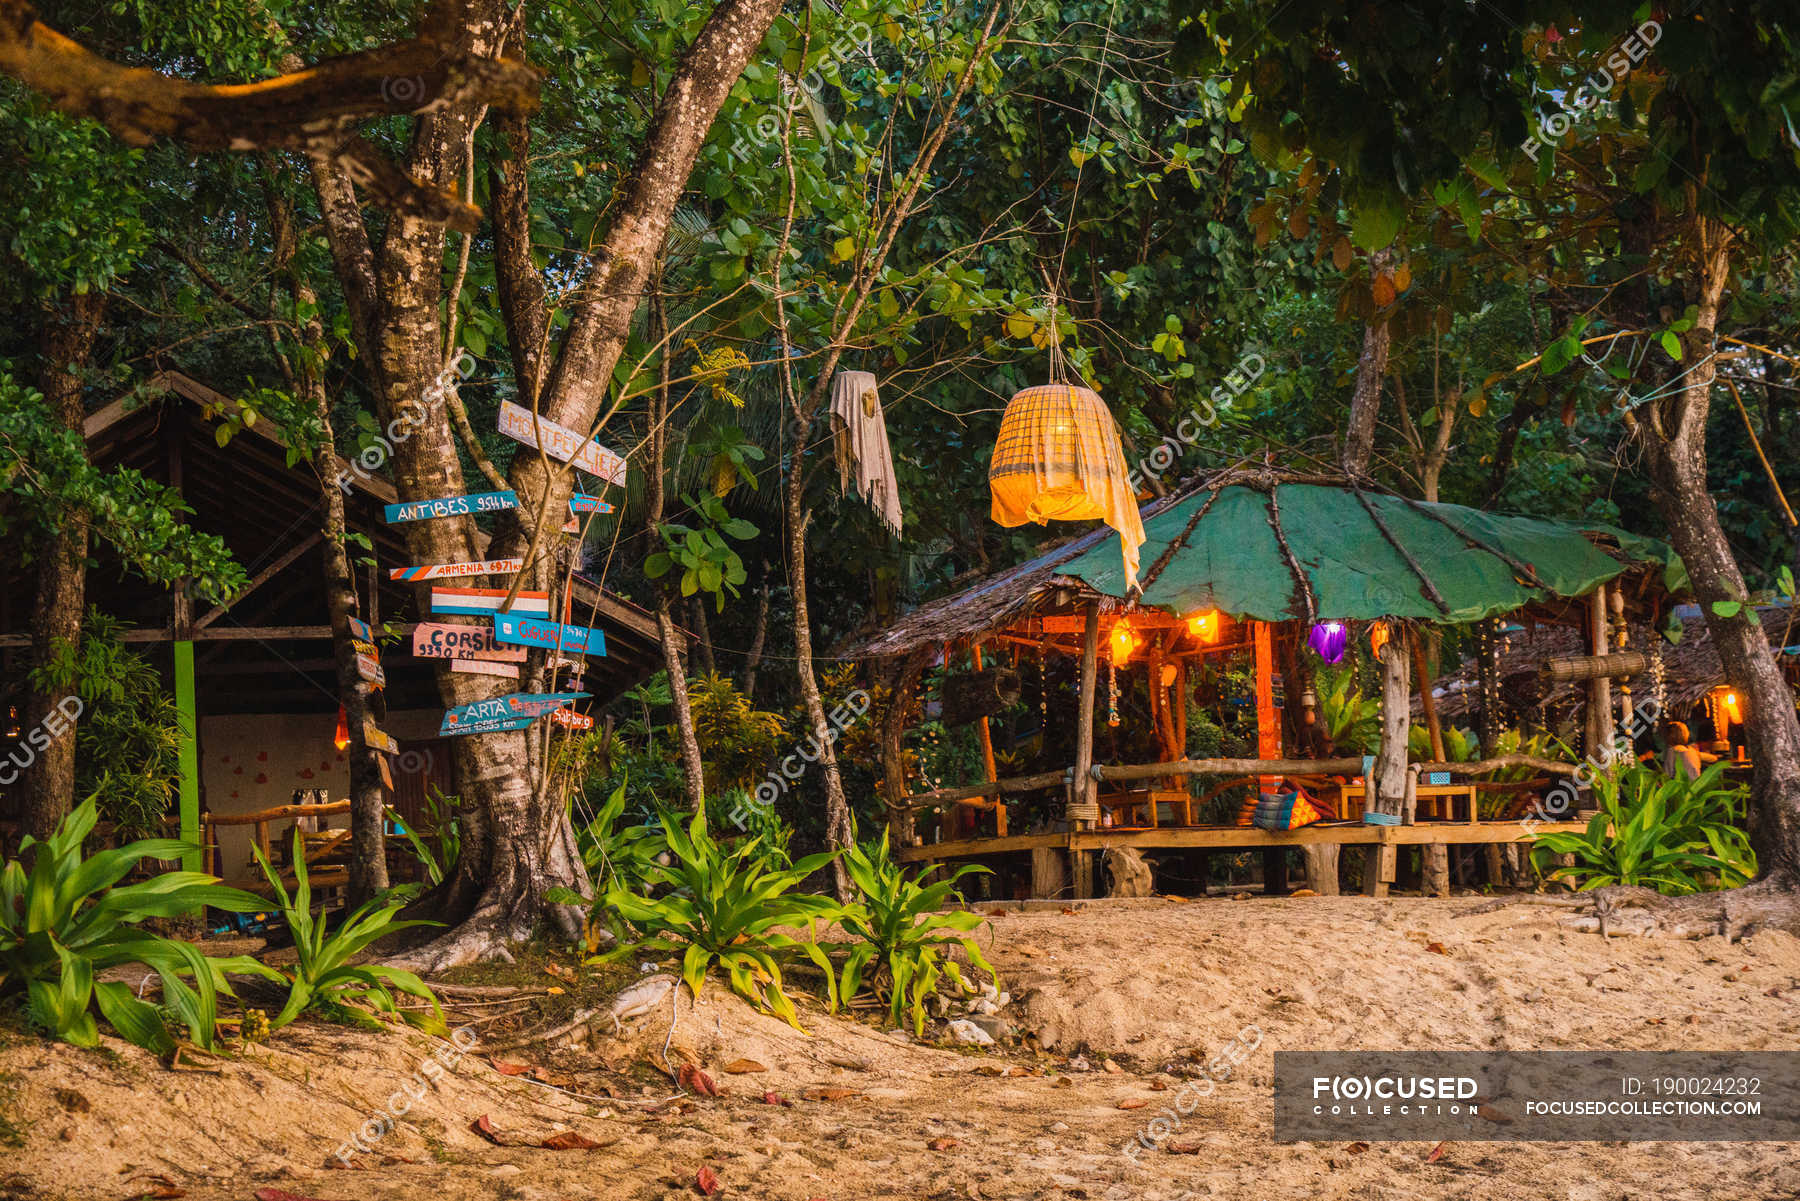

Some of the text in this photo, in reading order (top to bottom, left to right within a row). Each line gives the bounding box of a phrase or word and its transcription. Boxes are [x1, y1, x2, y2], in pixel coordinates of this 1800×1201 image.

[437, 563, 484, 576] ARMENIA
[490, 561, 512, 572] 6971
[419, 644, 475, 660] 9390 KM
